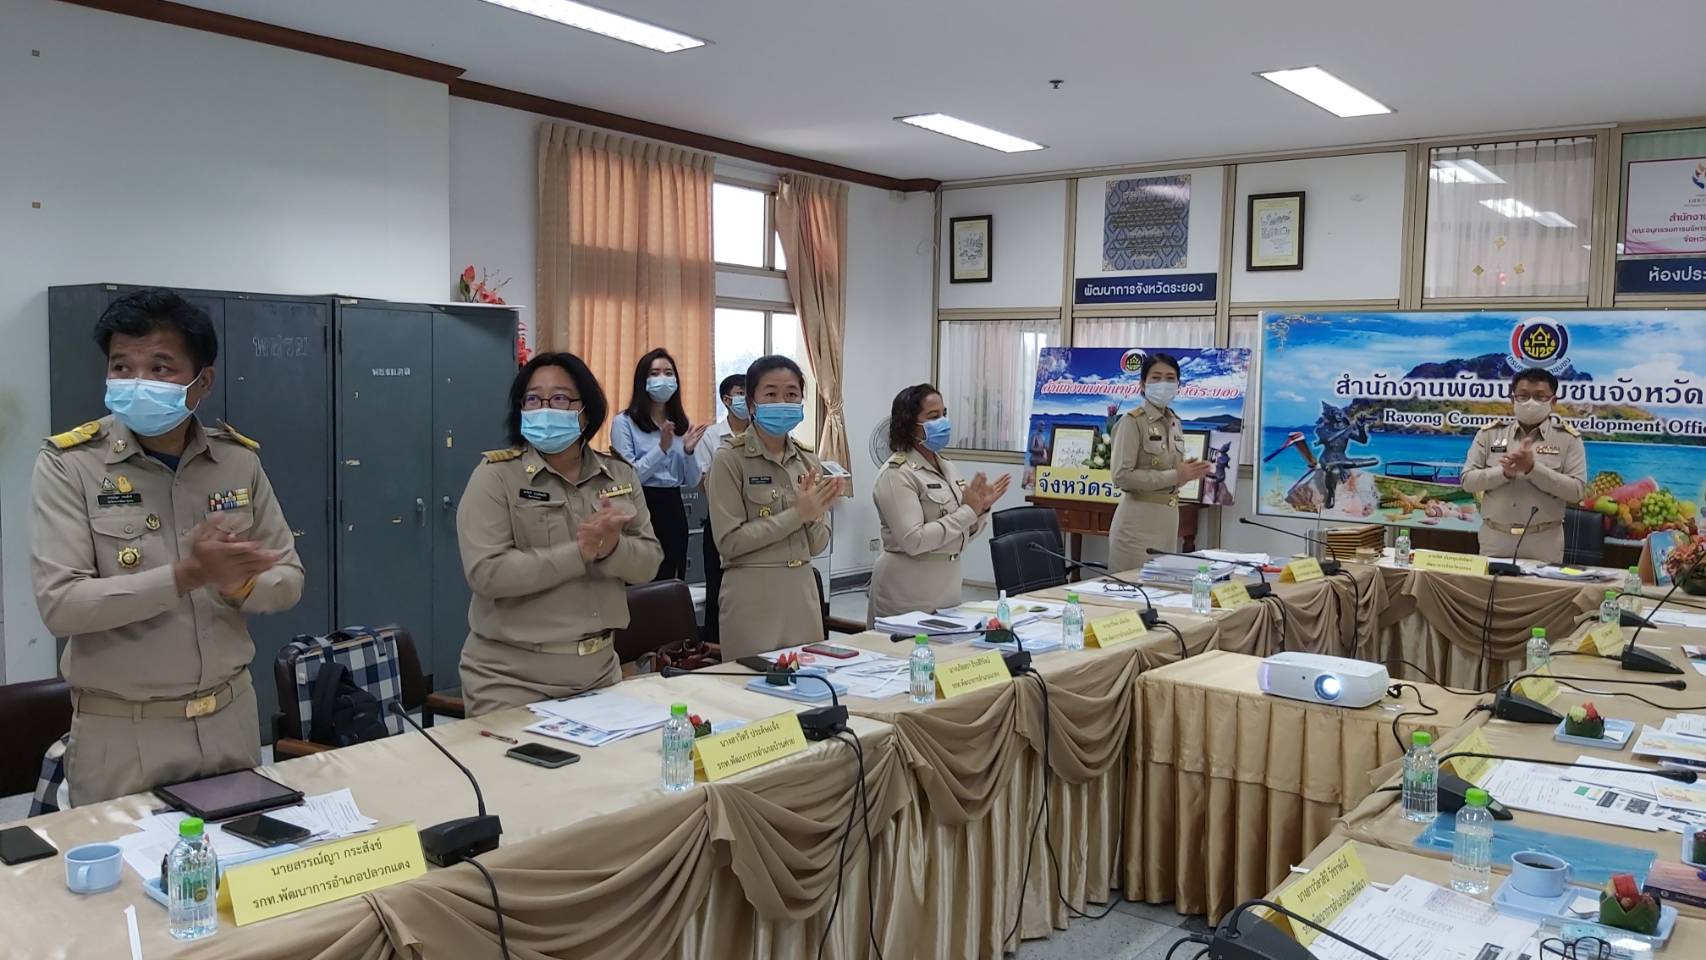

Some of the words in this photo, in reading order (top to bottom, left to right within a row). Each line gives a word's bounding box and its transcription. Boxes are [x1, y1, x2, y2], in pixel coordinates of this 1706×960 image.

[1084, 282, 1203, 296] พัฒนาการจังหวัดระยอง
[1384, 411, 1441, 425] Rayong
[1550, 415, 1661, 434] Dvelopment
[252, 859, 411, 909] รกท.พัฒนาการอำเภอปลวกแดง
